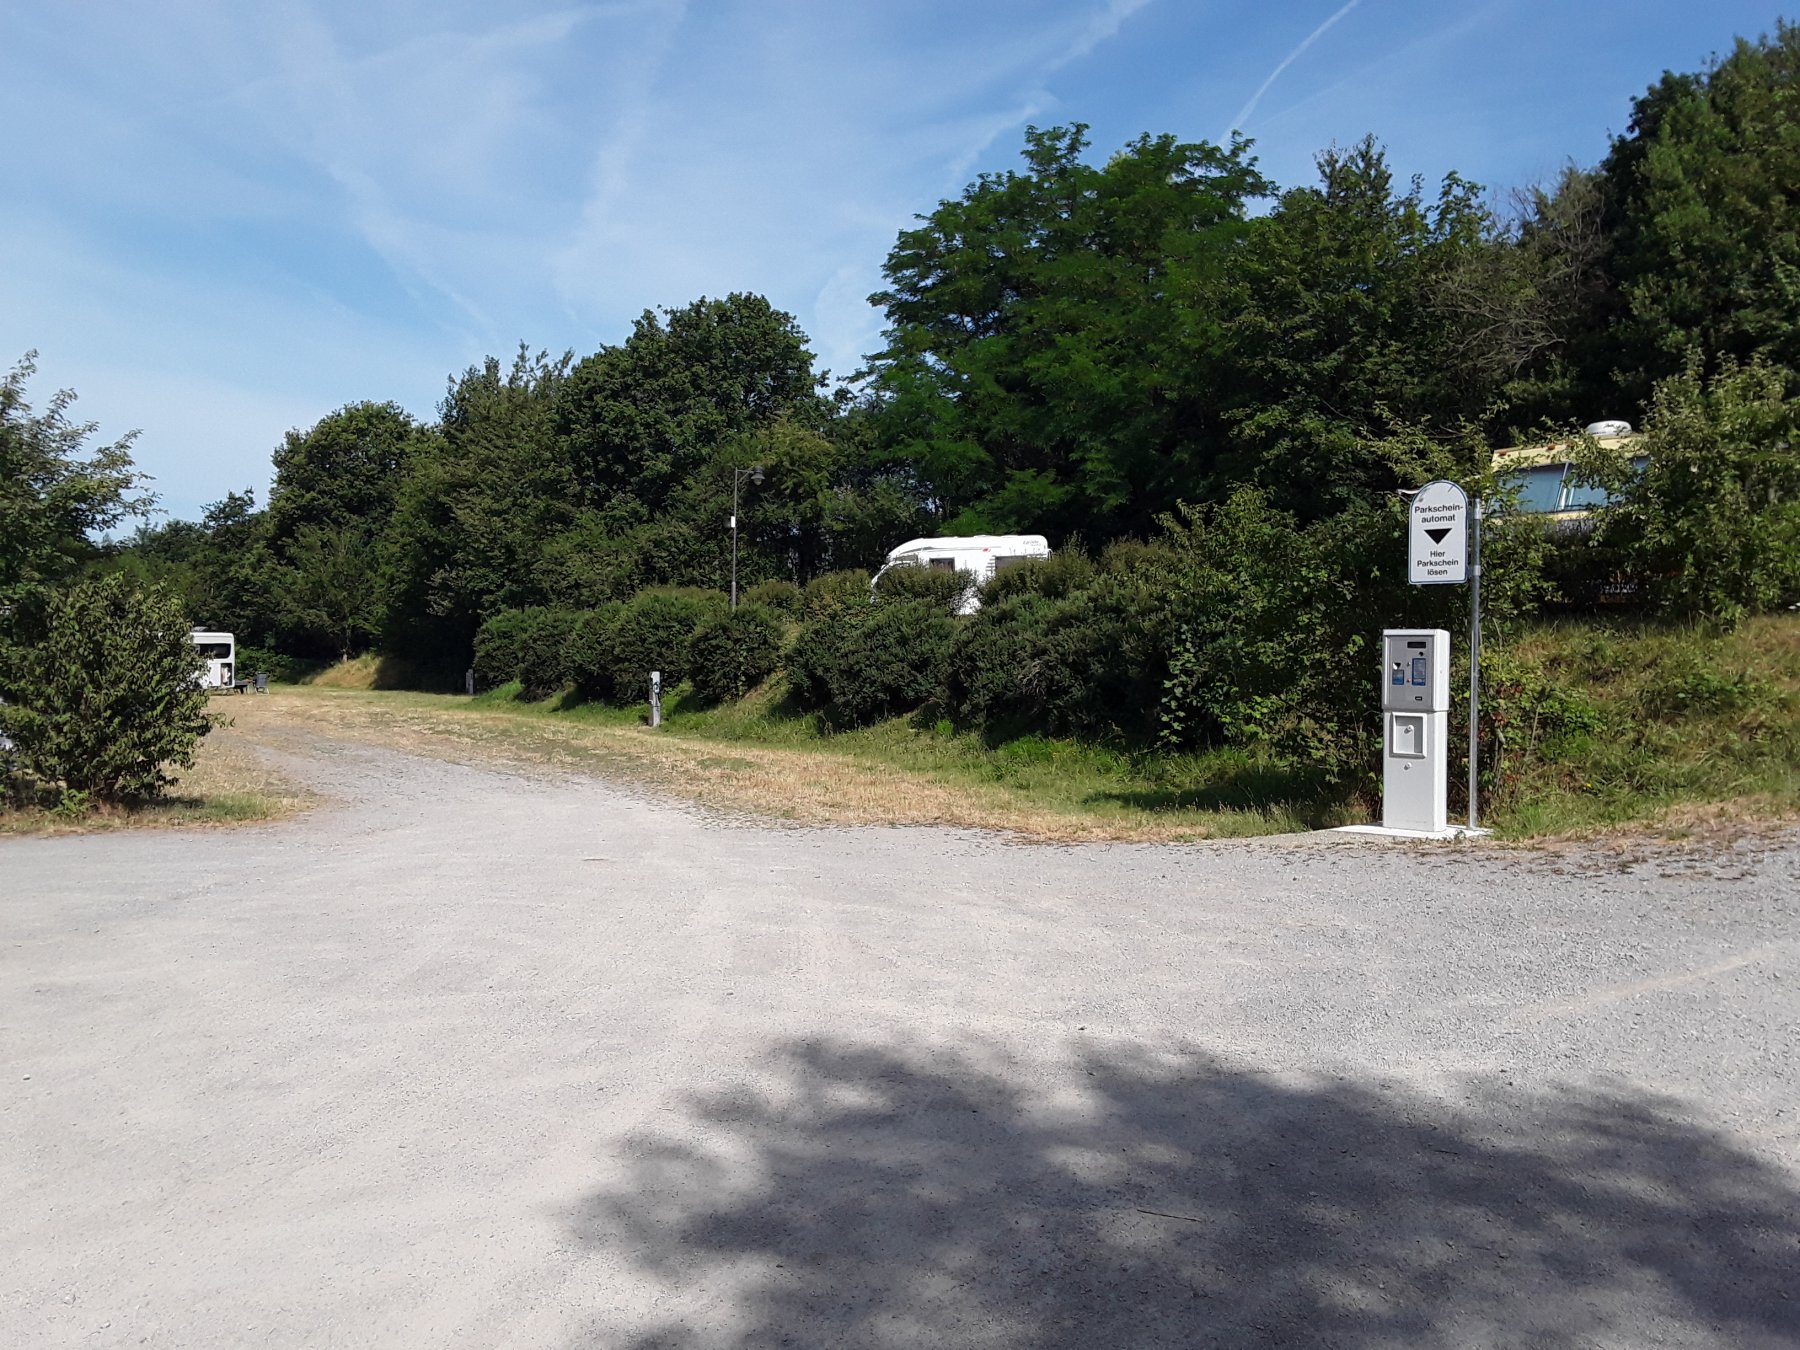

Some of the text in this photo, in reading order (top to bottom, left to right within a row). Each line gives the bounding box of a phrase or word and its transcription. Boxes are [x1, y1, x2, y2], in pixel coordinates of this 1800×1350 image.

[1414, 504, 1464, 513] Parkschein-
[1421, 514, 1456, 523] automat
[1417, 559, 1459, 567] Parkschein
[1427, 568, 1448, 576] lösen
